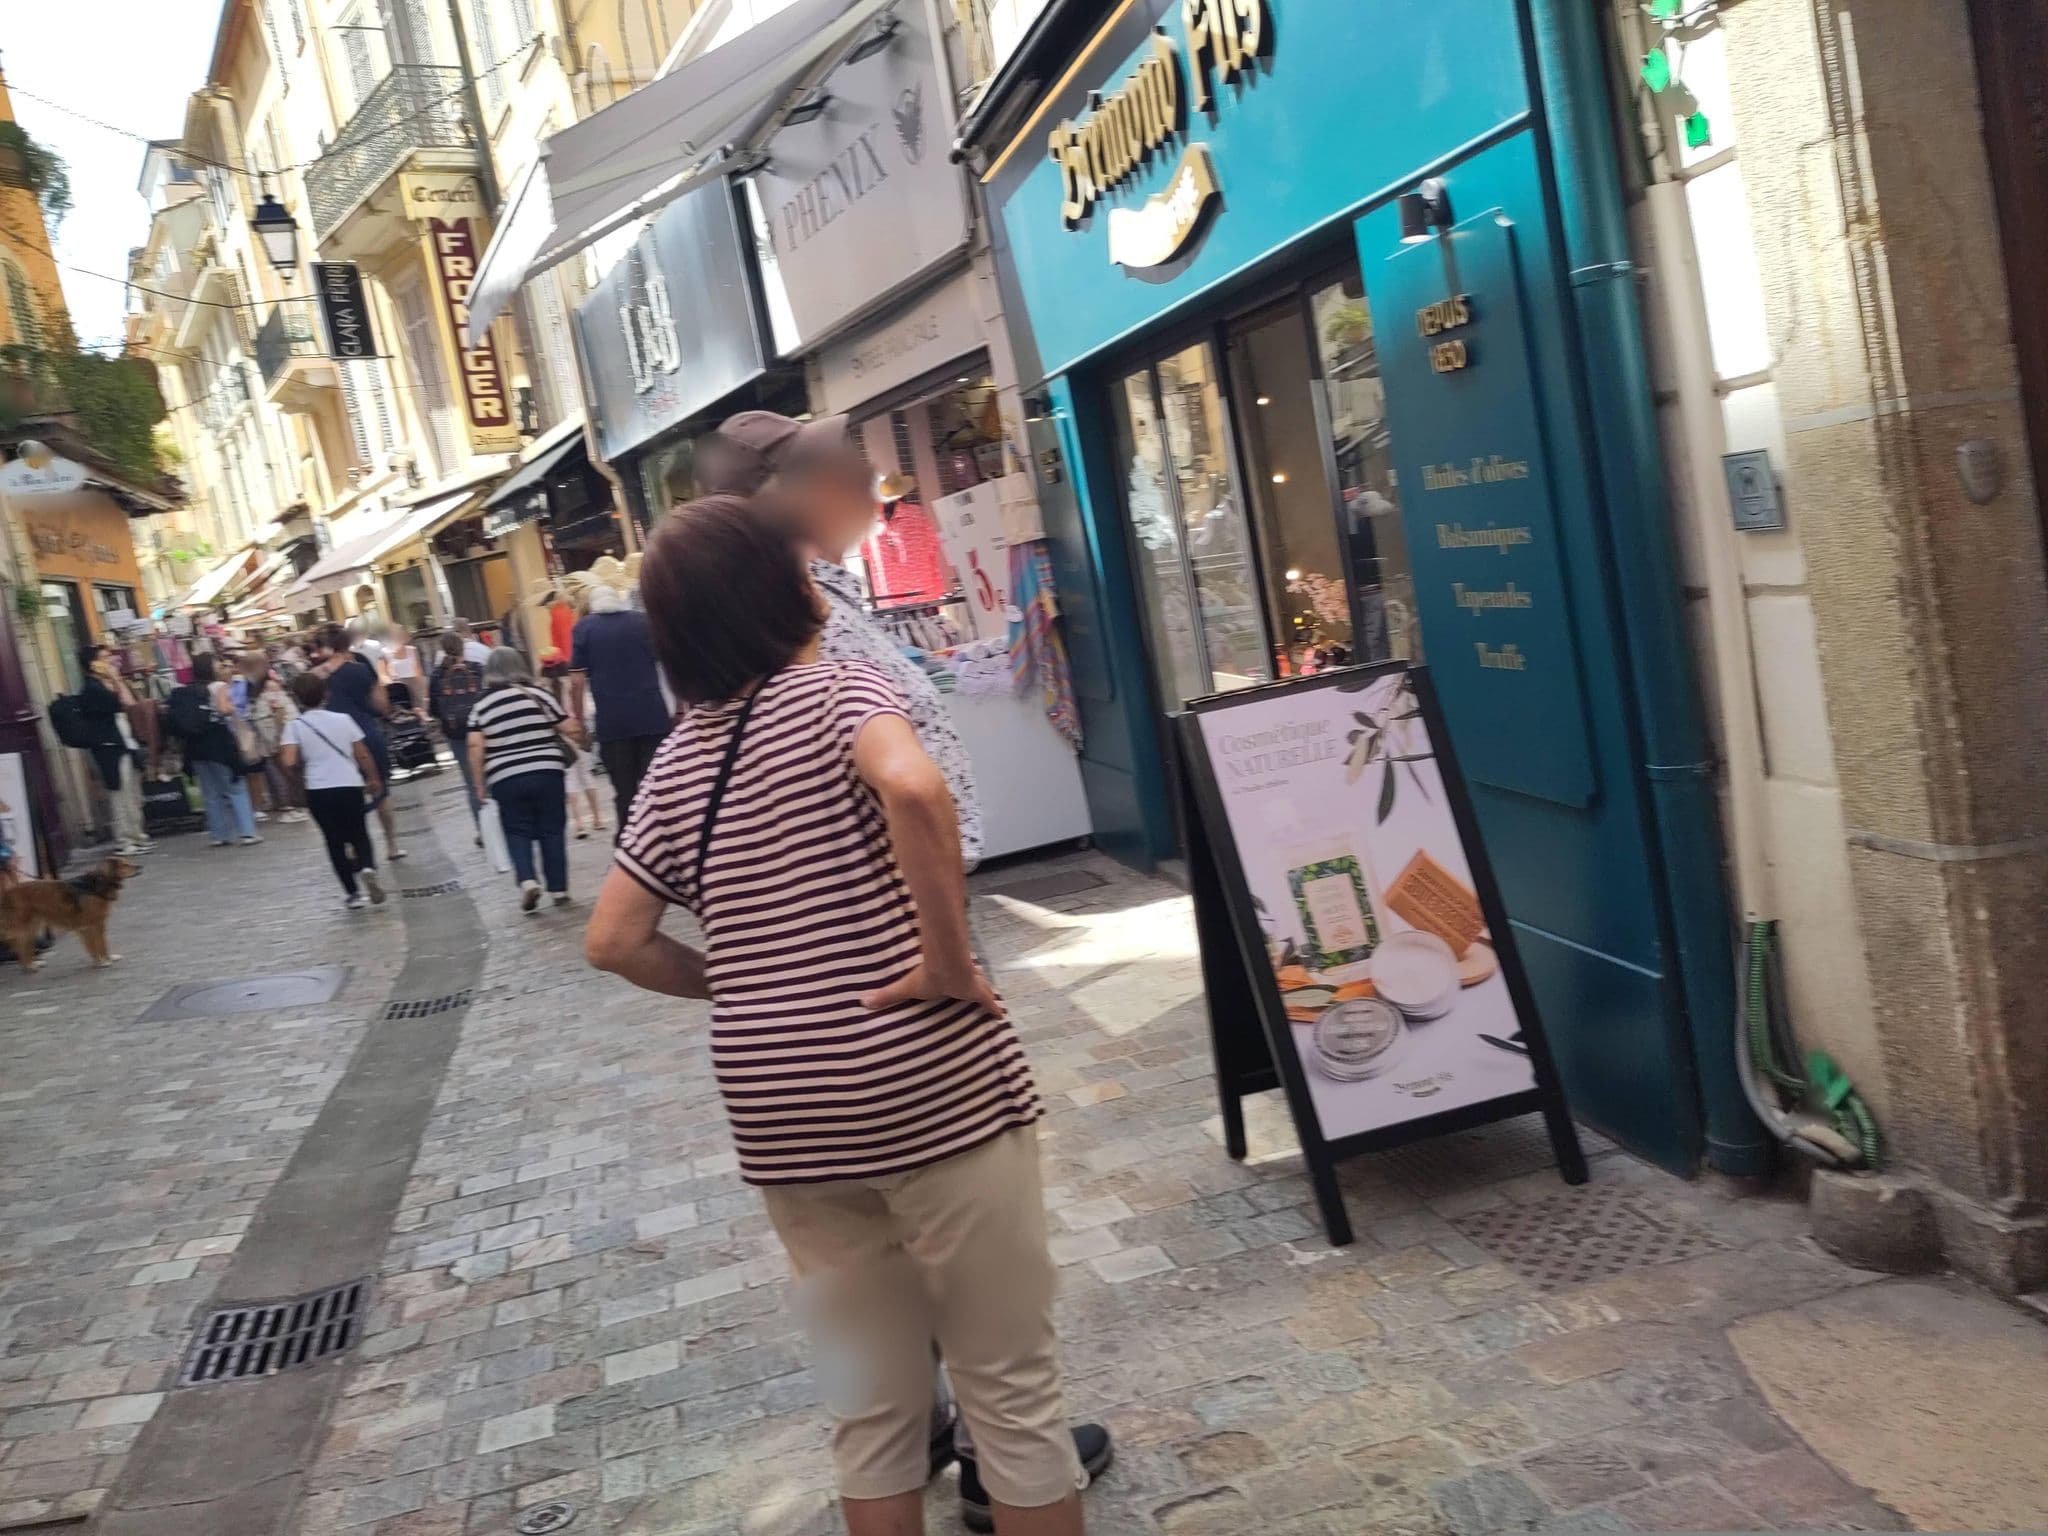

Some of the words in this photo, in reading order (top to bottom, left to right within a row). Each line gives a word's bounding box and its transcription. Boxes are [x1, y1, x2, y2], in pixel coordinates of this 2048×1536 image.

[334, 308, 362, 355] CLARA
[1218, 719, 1330, 755] Cosmétique
[1224, 738, 1338, 777] NATURELLE
